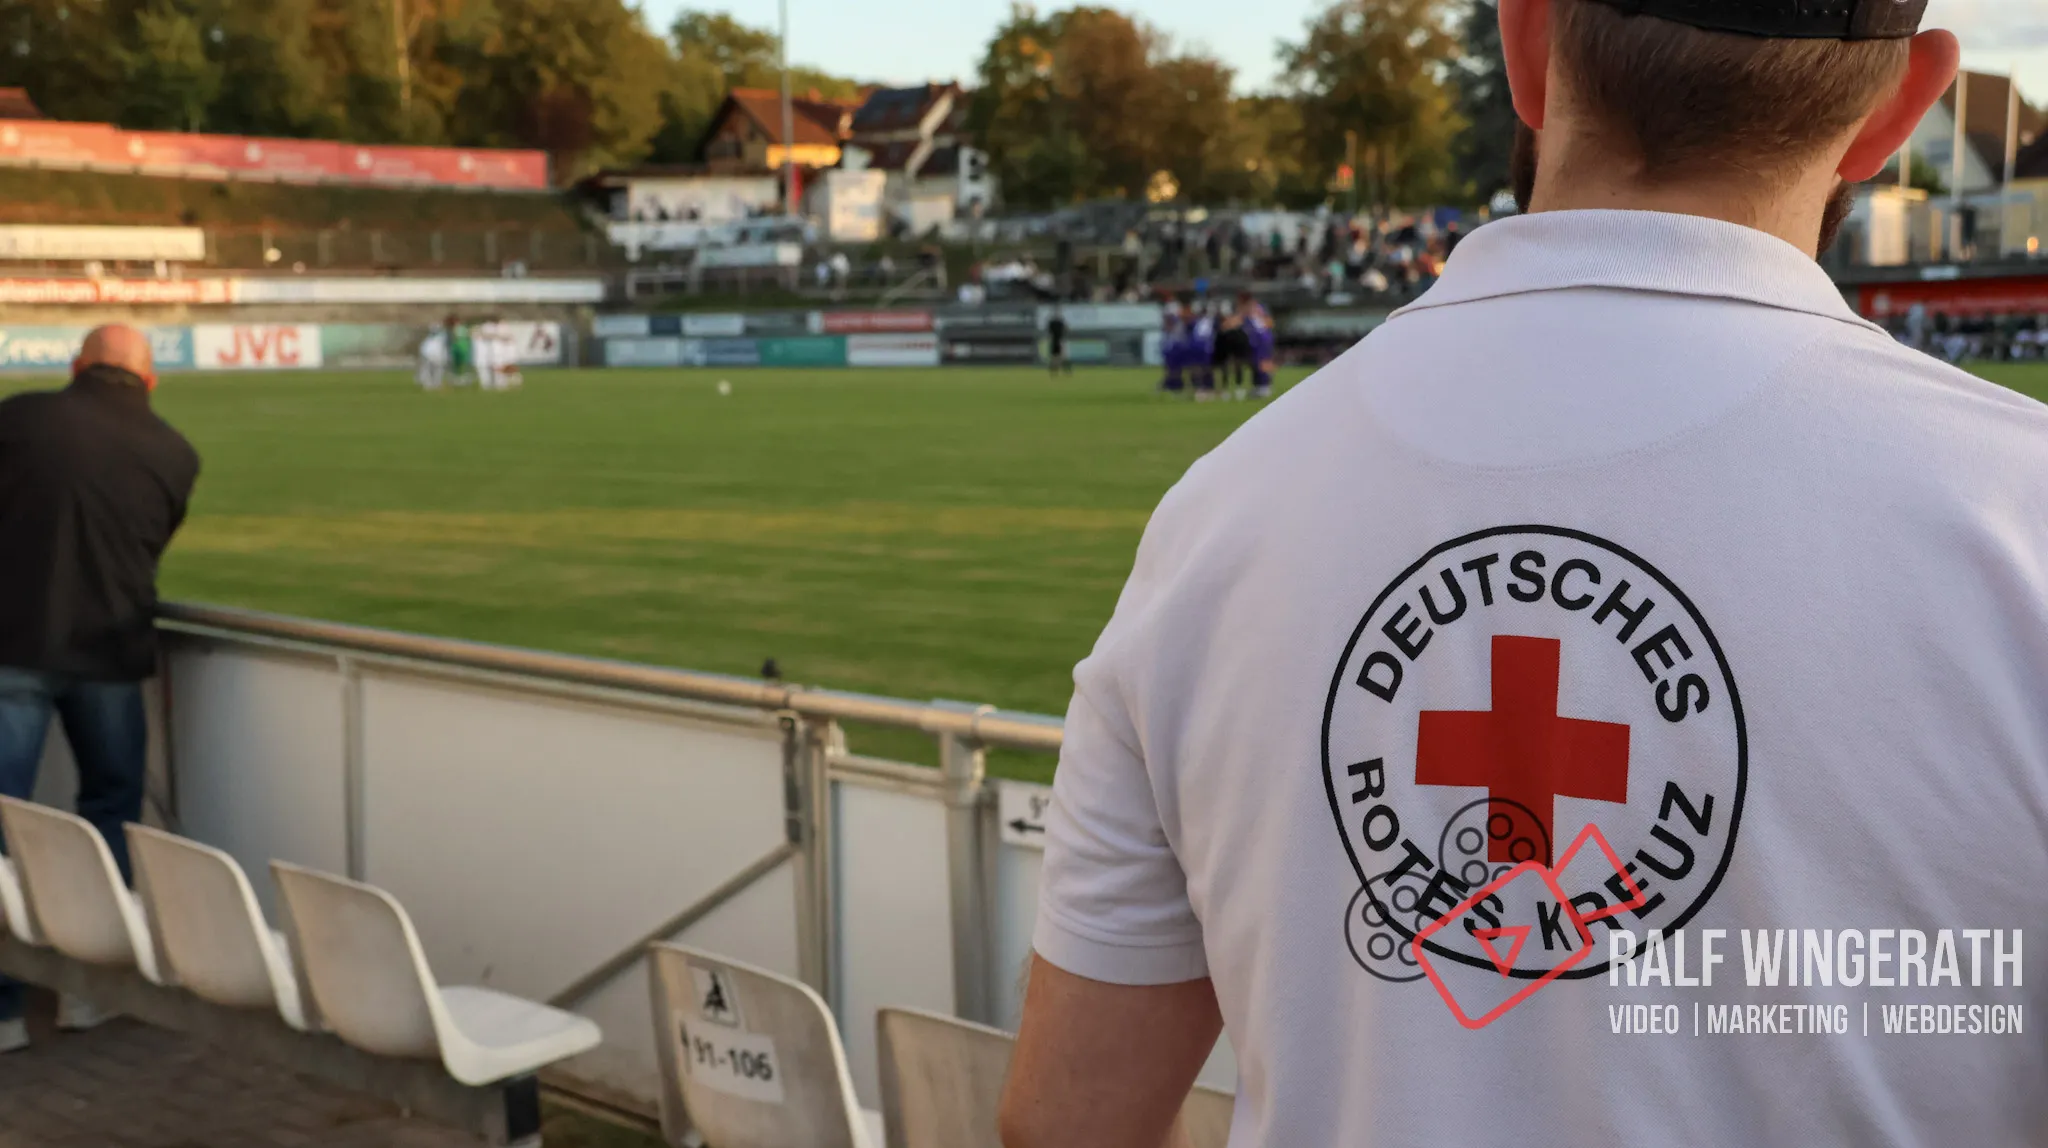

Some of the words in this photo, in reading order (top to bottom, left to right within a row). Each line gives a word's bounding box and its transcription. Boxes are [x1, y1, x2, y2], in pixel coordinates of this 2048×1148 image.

[217, 325, 300, 366] JVC
[1356, 550, 1710, 723] DEUTSCHES
[1347, 757, 1504, 940] ROTES
[1536, 781, 1714, 952] KREUZ
